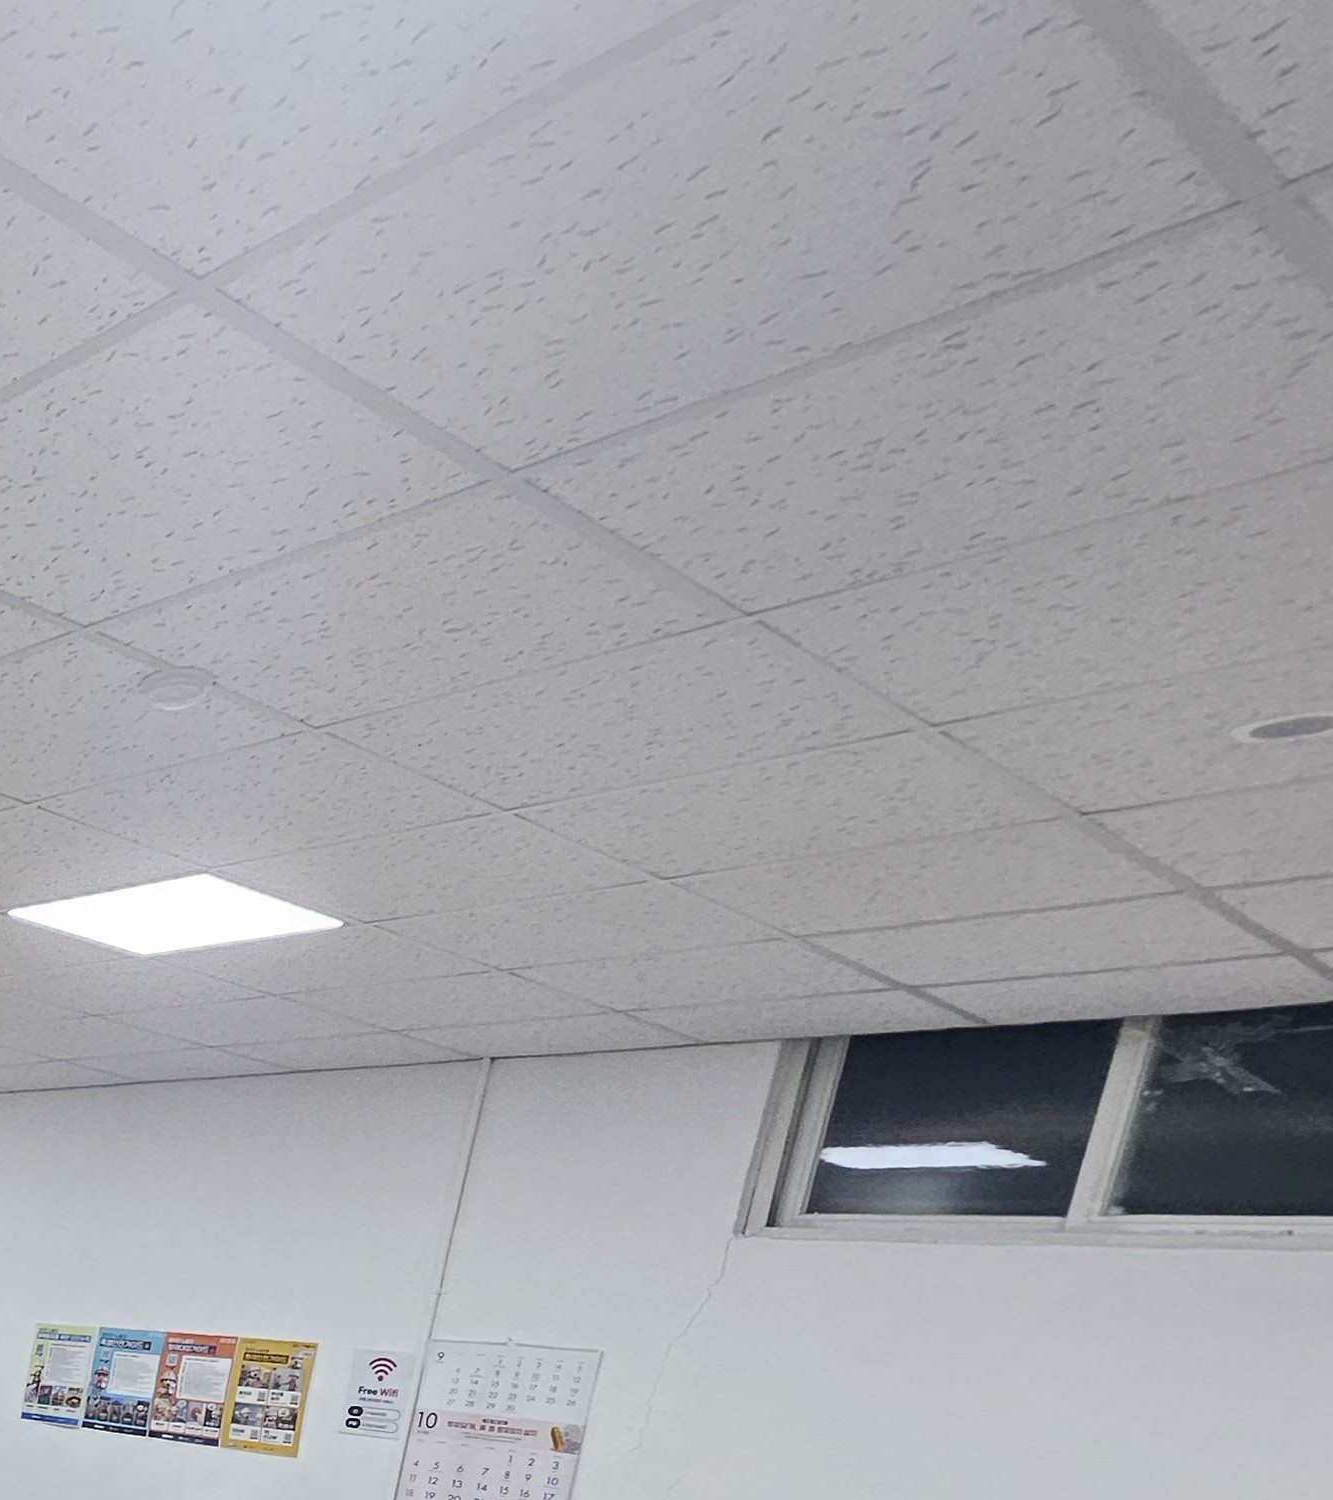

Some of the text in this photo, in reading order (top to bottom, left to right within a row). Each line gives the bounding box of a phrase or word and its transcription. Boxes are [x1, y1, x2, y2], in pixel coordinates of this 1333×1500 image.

[437, 1352, 445, 1360] 9
[358, 1386, 399, 1397] Free Wifi
[417, 1411, 438, 1429] 10
[508, 1455, 559, 1470] 1 2 3
[433, 1462, 440, 1470] 5
[456, 1465, 464, 1473] 6
[481, 1468, 489, 1476] 7
[504, 1471, 510, 1480] 8
[525, 1474, 532, 1483] 9
[546, 1477, 559, 1486] 10
[410, 1474, 555, 1500] 11 12 13 14 15 16 17
[425, 1491, 436, 1499] 19
